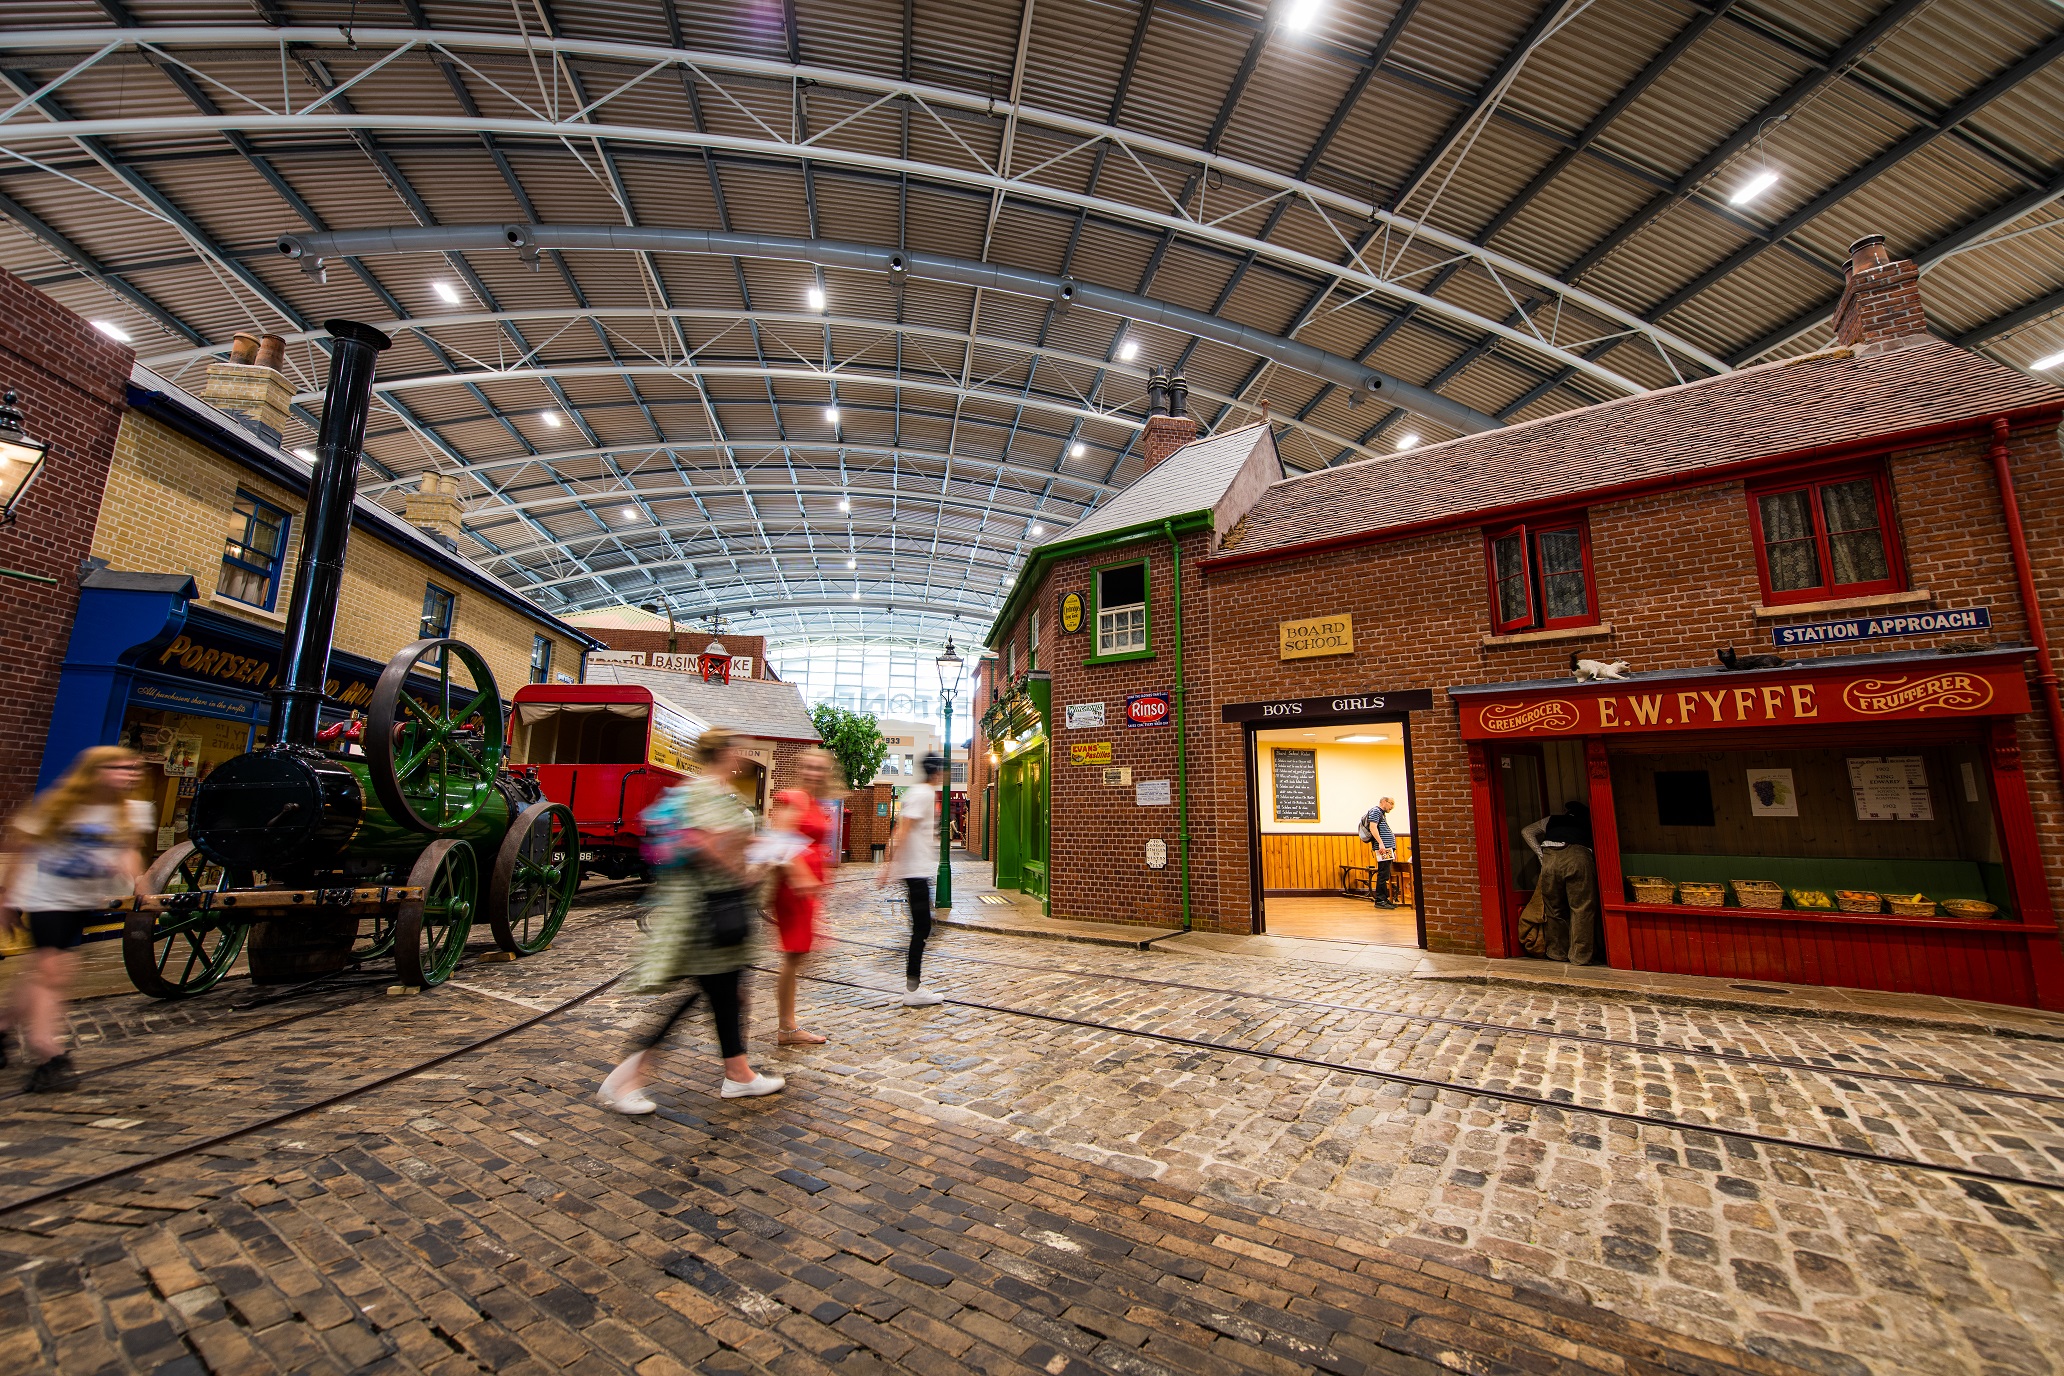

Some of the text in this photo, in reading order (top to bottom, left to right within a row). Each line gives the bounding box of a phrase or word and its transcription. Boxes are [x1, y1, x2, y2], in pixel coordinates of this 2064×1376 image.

[1287, 622, 1345, 638] BOARD
[1782, 611, 1984, 643] STATION APPROACH.
[1285, 635, 1348, 651] SCHOOL
[159, 634, 269, 686] PORTSEA
[1858, 676, 1974, 711] FRUITERER
[1132, 700, 1165, 717] Rinso
[1263, 696, 1385, 717] BOYS GIRLS
[1488, 703, 1564, 731] GREENGROCER
[554, 852, 592, 861] SV86
